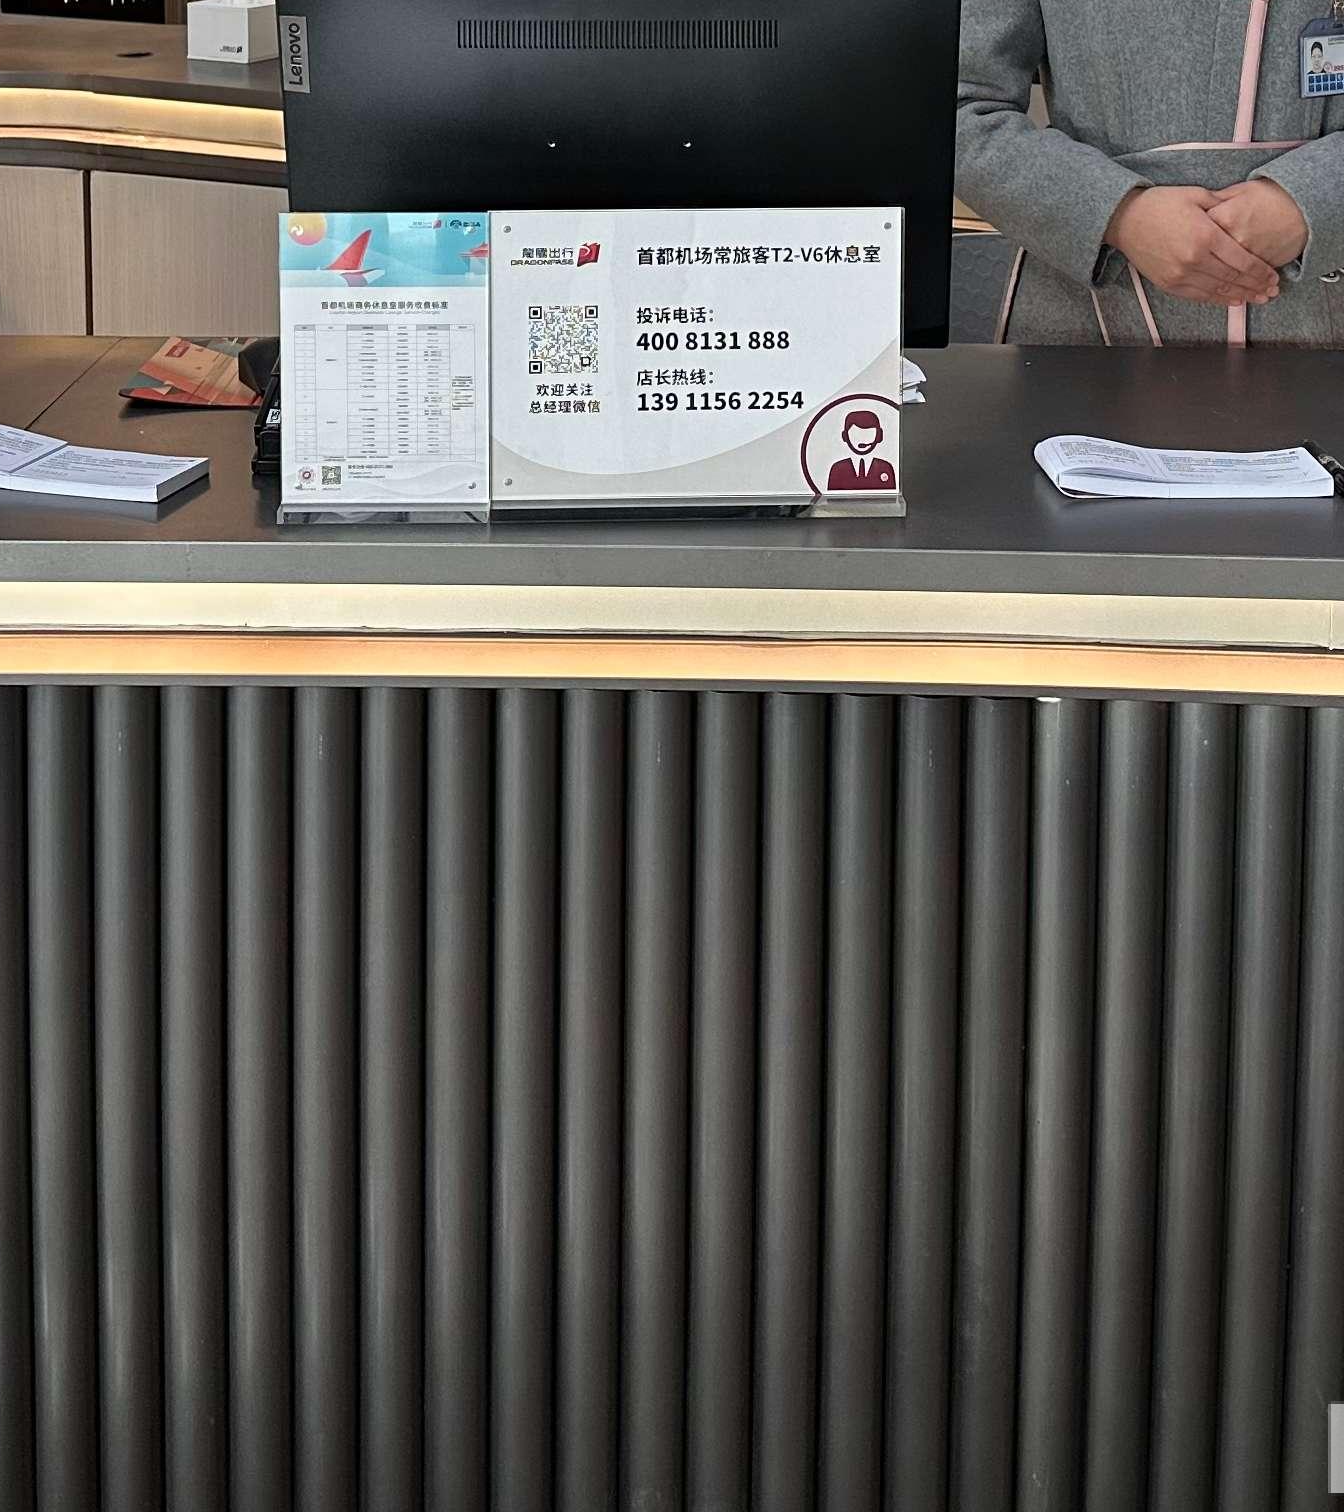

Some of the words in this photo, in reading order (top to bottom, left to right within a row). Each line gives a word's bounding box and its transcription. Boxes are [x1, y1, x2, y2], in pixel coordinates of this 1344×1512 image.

[288, 22, 304, 87] Lenovo
[636, 244, 882, 266] 首都机场常旅客T2-V6休息室
[636, 331, 679, 351] 400
[685, 331, 742, 351] 8131
[748, 330, 790, 350] 888
[536, 383, 594, 397] 欢迎关注
[529, 400, 601, 414] 总经理微信
[637, 392, 679, 411] 139
[685, 392, 742, 411] 1156
[747, 391, 804, 410] 2254
